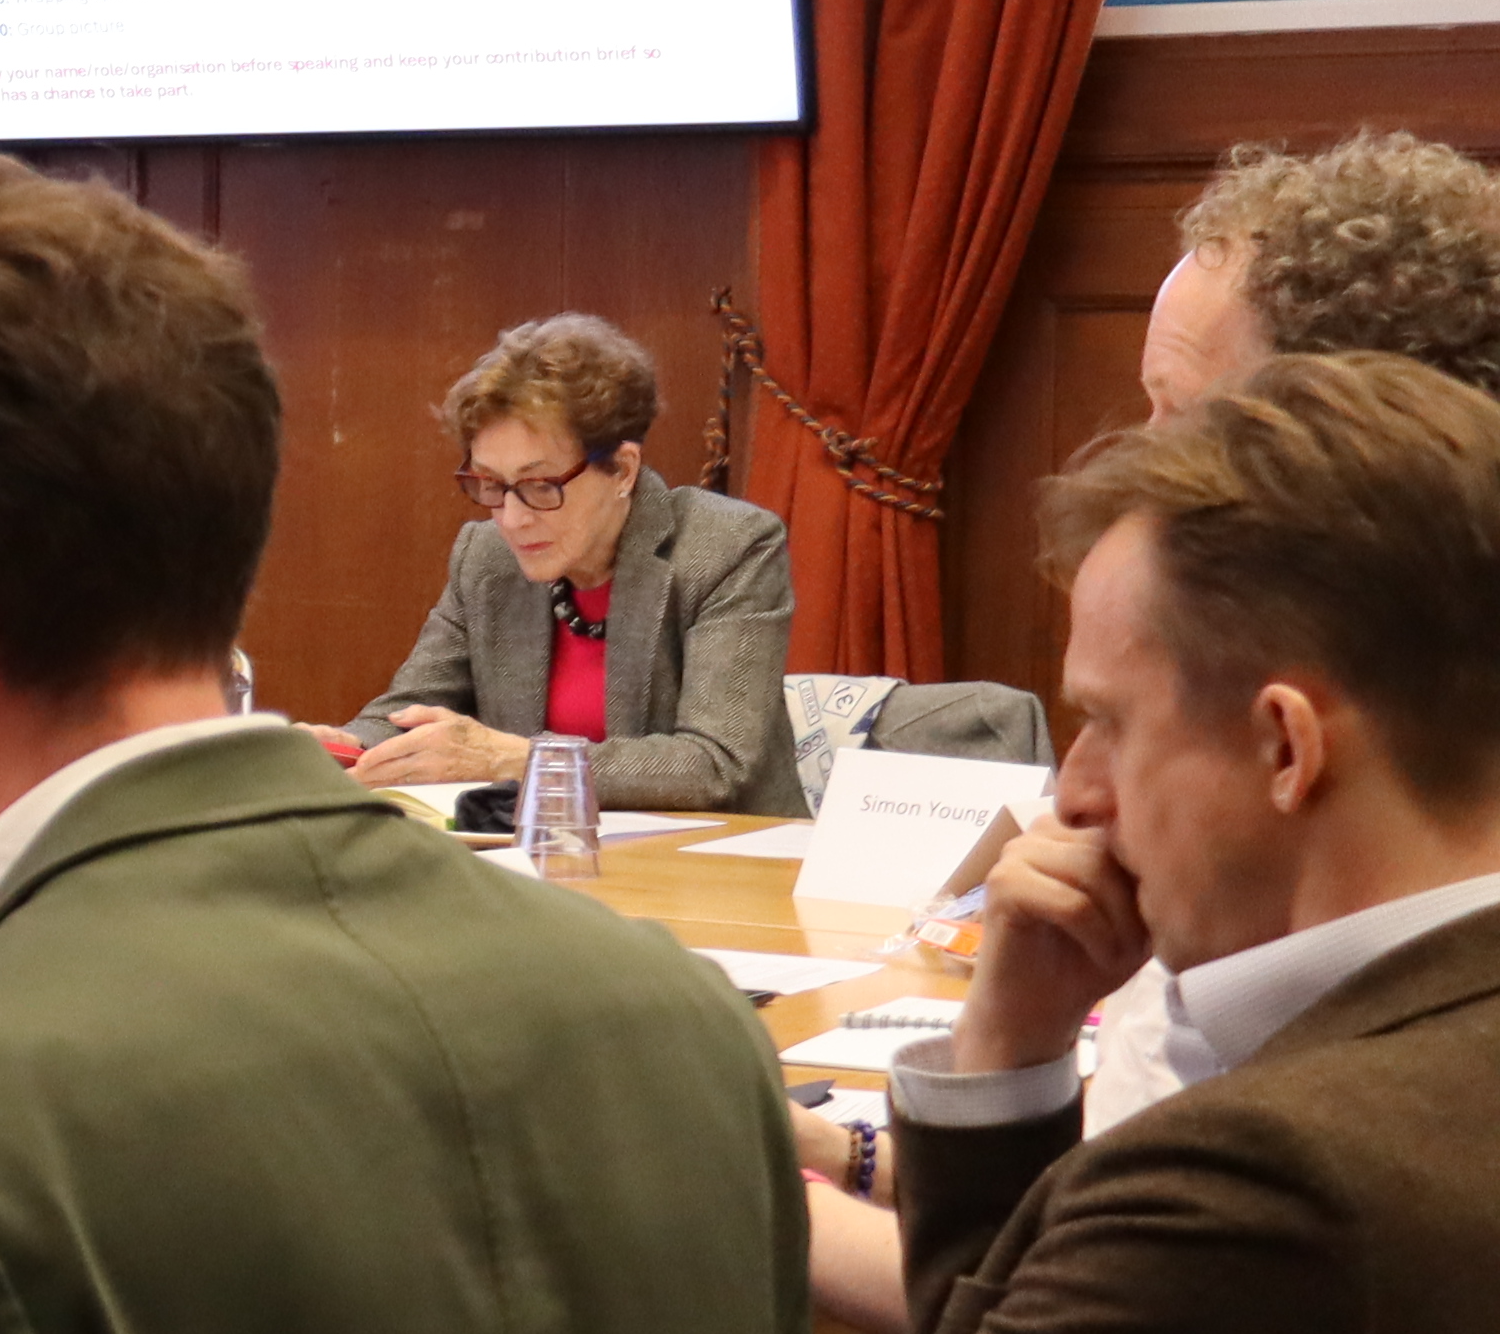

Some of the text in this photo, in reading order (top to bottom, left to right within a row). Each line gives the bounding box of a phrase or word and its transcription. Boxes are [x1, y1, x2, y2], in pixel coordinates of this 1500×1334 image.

[6, 68, 39, 83] your
[230, 57, 282, 73] before
[287, 55, 359, 74] speaking
[363, 53, 394, 68] and
[398, 53, 438, 69] keep
[442, 53, 479, 69] your
[485, 48, 591, 64] contribution
[596, 44, 637, 61] brief
[642, 48, 662, 59] so
[860, 794, 989, 827] Simon Young
